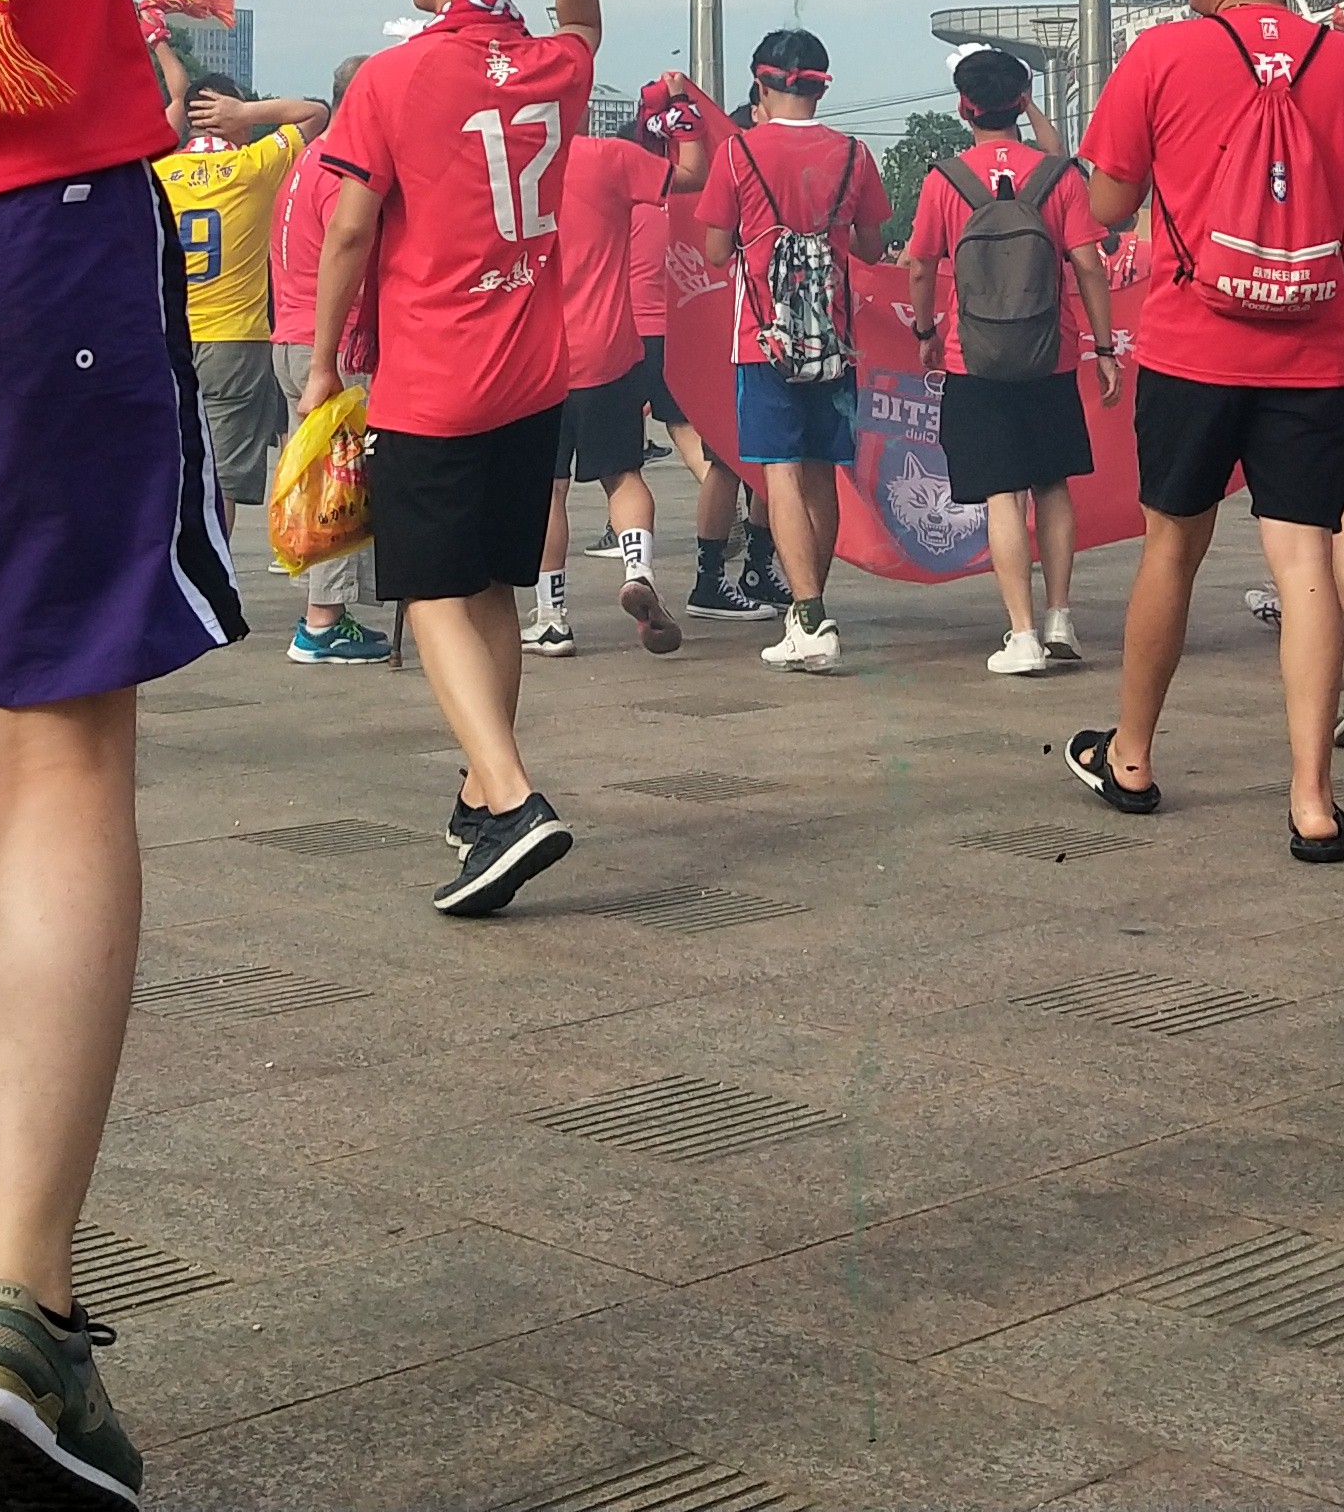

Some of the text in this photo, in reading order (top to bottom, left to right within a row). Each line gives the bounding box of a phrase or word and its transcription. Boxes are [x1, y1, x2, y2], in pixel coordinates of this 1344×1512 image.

[461, 100, 562, 241] 12
[179, 207, 222, 283] 9
[1216, 275, 1337, 305] ATHLETIC
